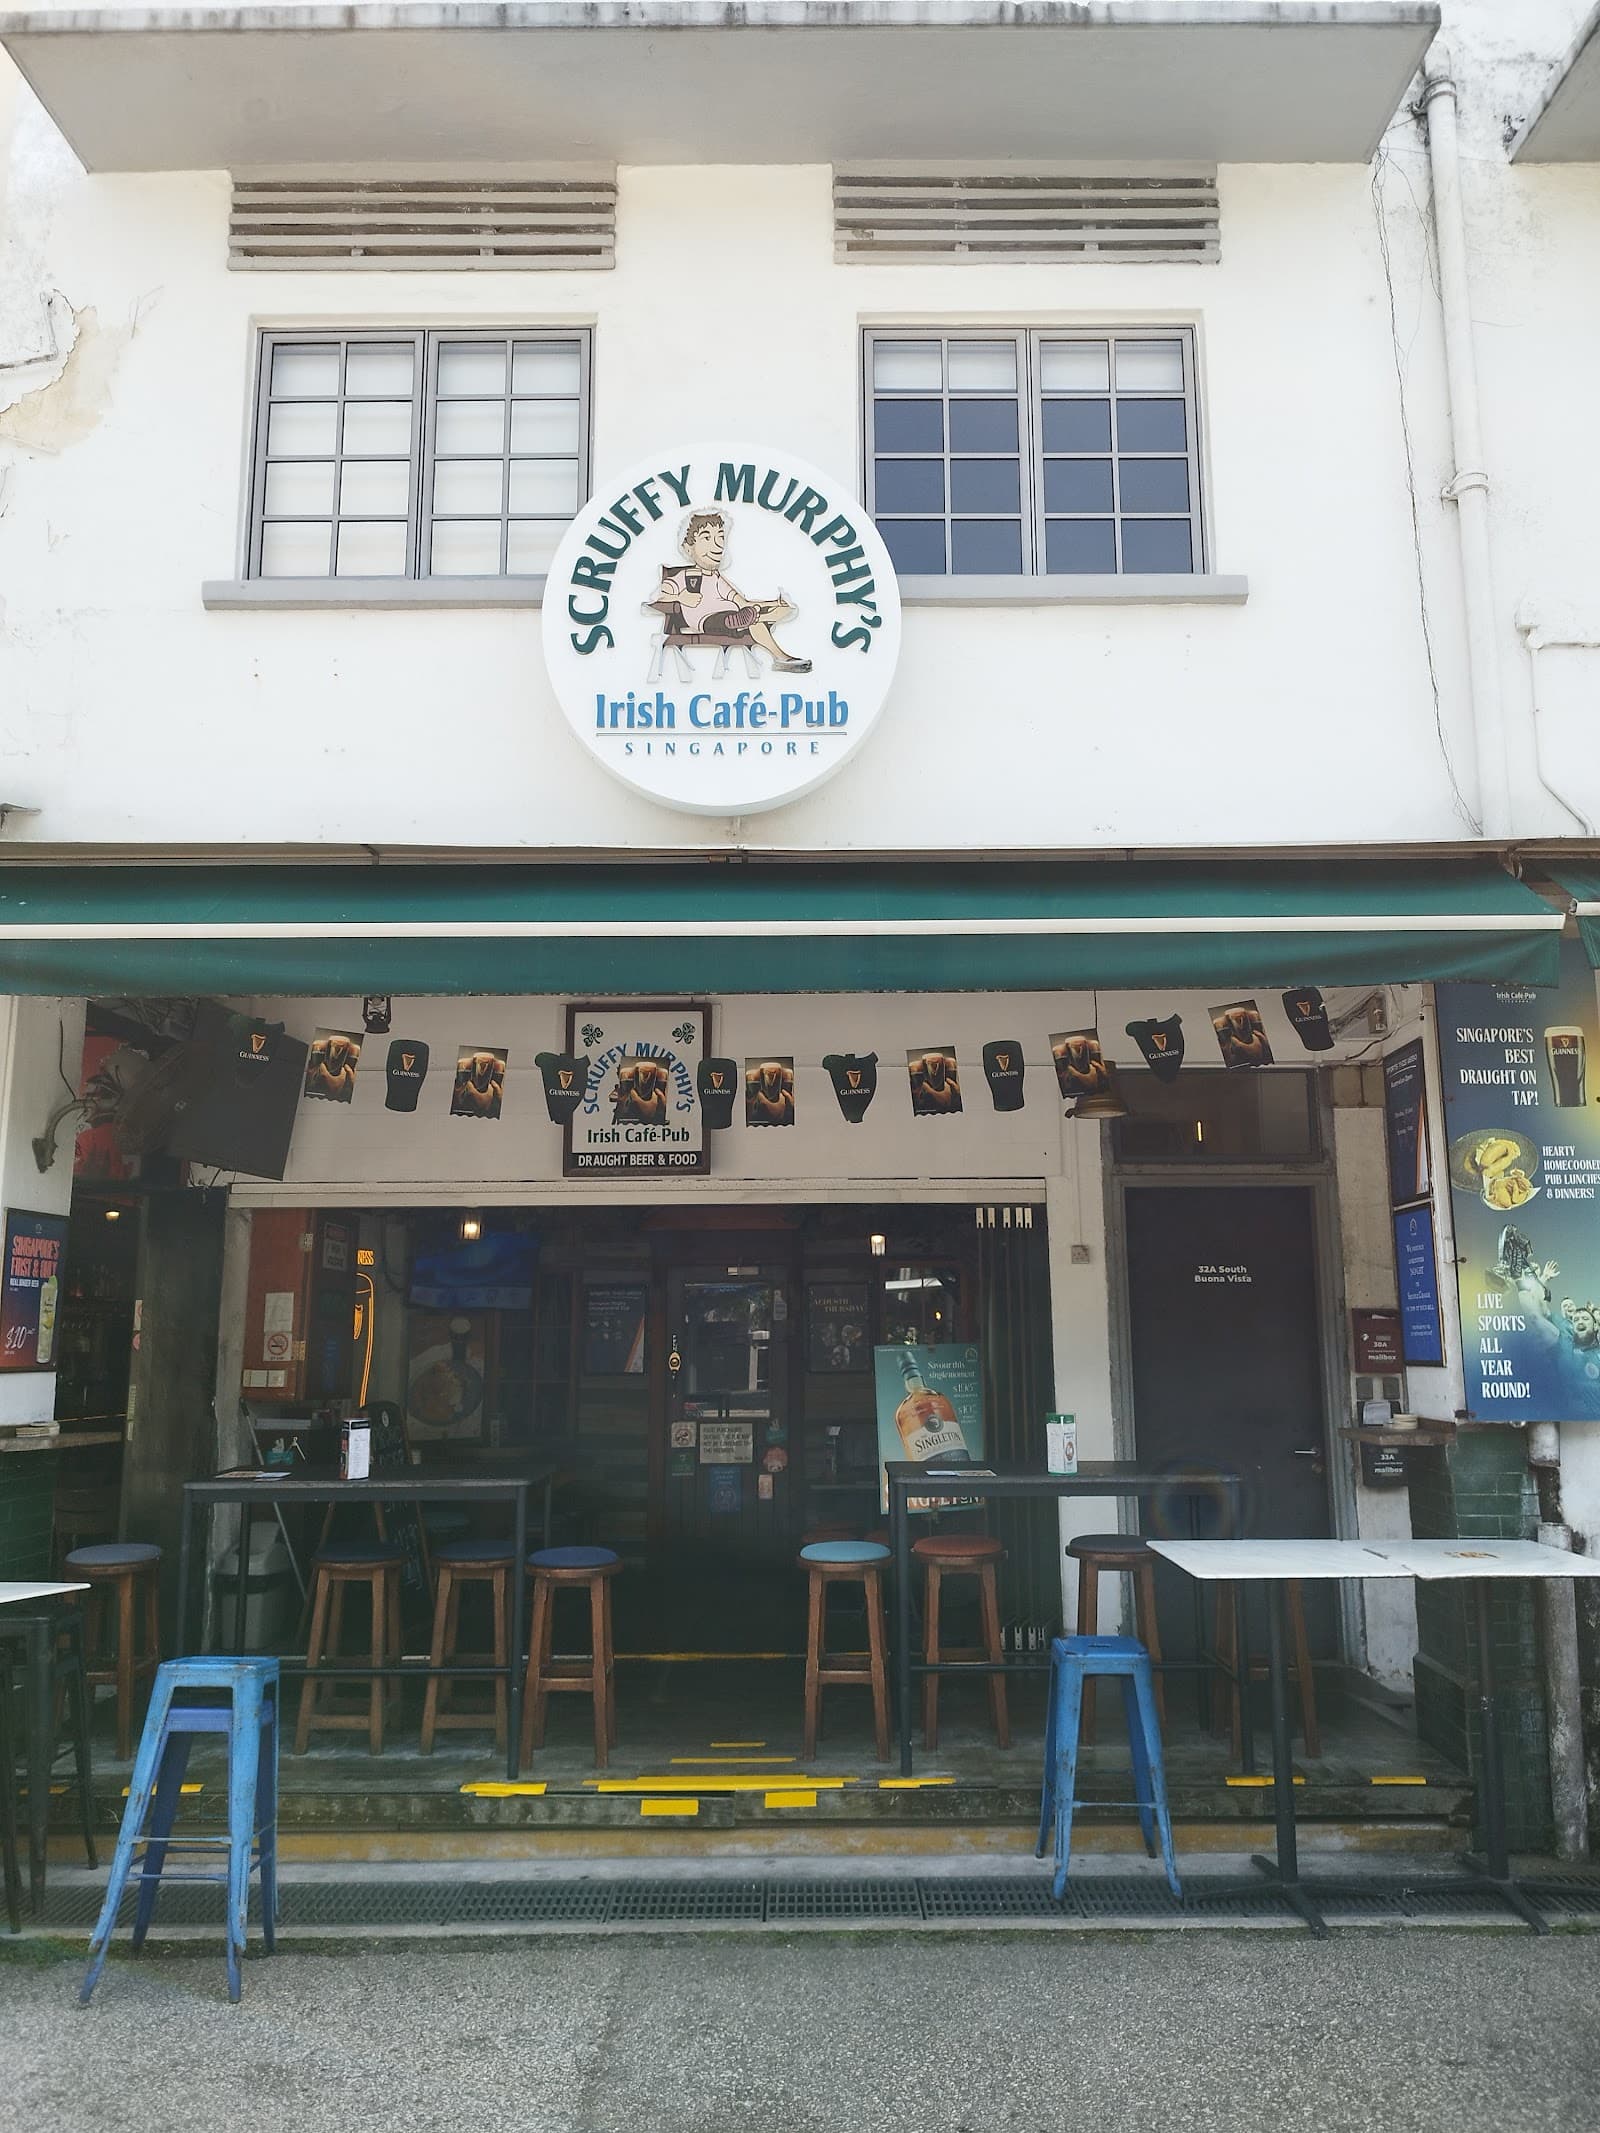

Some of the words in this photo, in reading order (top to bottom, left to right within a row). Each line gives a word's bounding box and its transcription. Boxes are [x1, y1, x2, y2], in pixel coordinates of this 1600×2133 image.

[568, 464, 691, 655] SCRUFFY
[713, 462, 882, 654] MURPHY'S
[596, 692, 675, 729] Irish
[689, 691, 849, 729] Café-Pub
[624, 741, 820, 755] SINGAPORE
[1456, 1027, 1534, 1043] SINGAPORE'S
[239, 1051, 271, 1062] GUINNESS
[1149, 1049, 1180, 1060] GUINNESS
[1504, 1048, 1535, 1064] BEST
[392, 1068, 420, 1078] GUINNESS
[583, 1043, 628, 1115] SCRUFFY
[991, 1070, 1019, 1078] GUINNESS
[1460, 1069, 1516, 1085] DRAUGHT
[1520, 1069, 1537, 1085] ON
[549, 1088, 580, 1097] GUINNESS
[840, 1087, 870, 1096] GUINNESS
[1511, 1090, 1539, 1106] TAP!
[587, 1129, 620, 1144] Irish
[625, 1127, 690, 1143] Café-Pub
[1542, 1145, 1576, 1157] HEARTY
[578, 1154, 628, 1167] DRAUGHT
[629, 1154, 655, 1166] BEER
[657, 1154, 666, 1165] &
[668, 1152, 697, 1165] FOOD
[1545, 1174, 1562, 1185] PUB
[1564, 1173, 1600, 1185] LUNCHES
[1546, 1188, 1554, 1199] &
[1555, 1187, 1595, 1199] DINNERS!
[1198, 1265, 1216, 1274] 32A
[1218, 1265, 1247, 1274] South
[1194, 1274, 1225, 1283] Buona
[1226, 1274, 1252, 1283] Vista
[1477, 1293, 1503, 1309] LIVE
[1478, 1315, 1526, 1332] SPORTS
[1480, 1337, 1503, 1354] ALL
[1480, 1359, 1513, 1376] YEAR
[1482, 1381, 1531, 1398] ROUND!
[914, 1431, 962, 1454] SINGLETON
